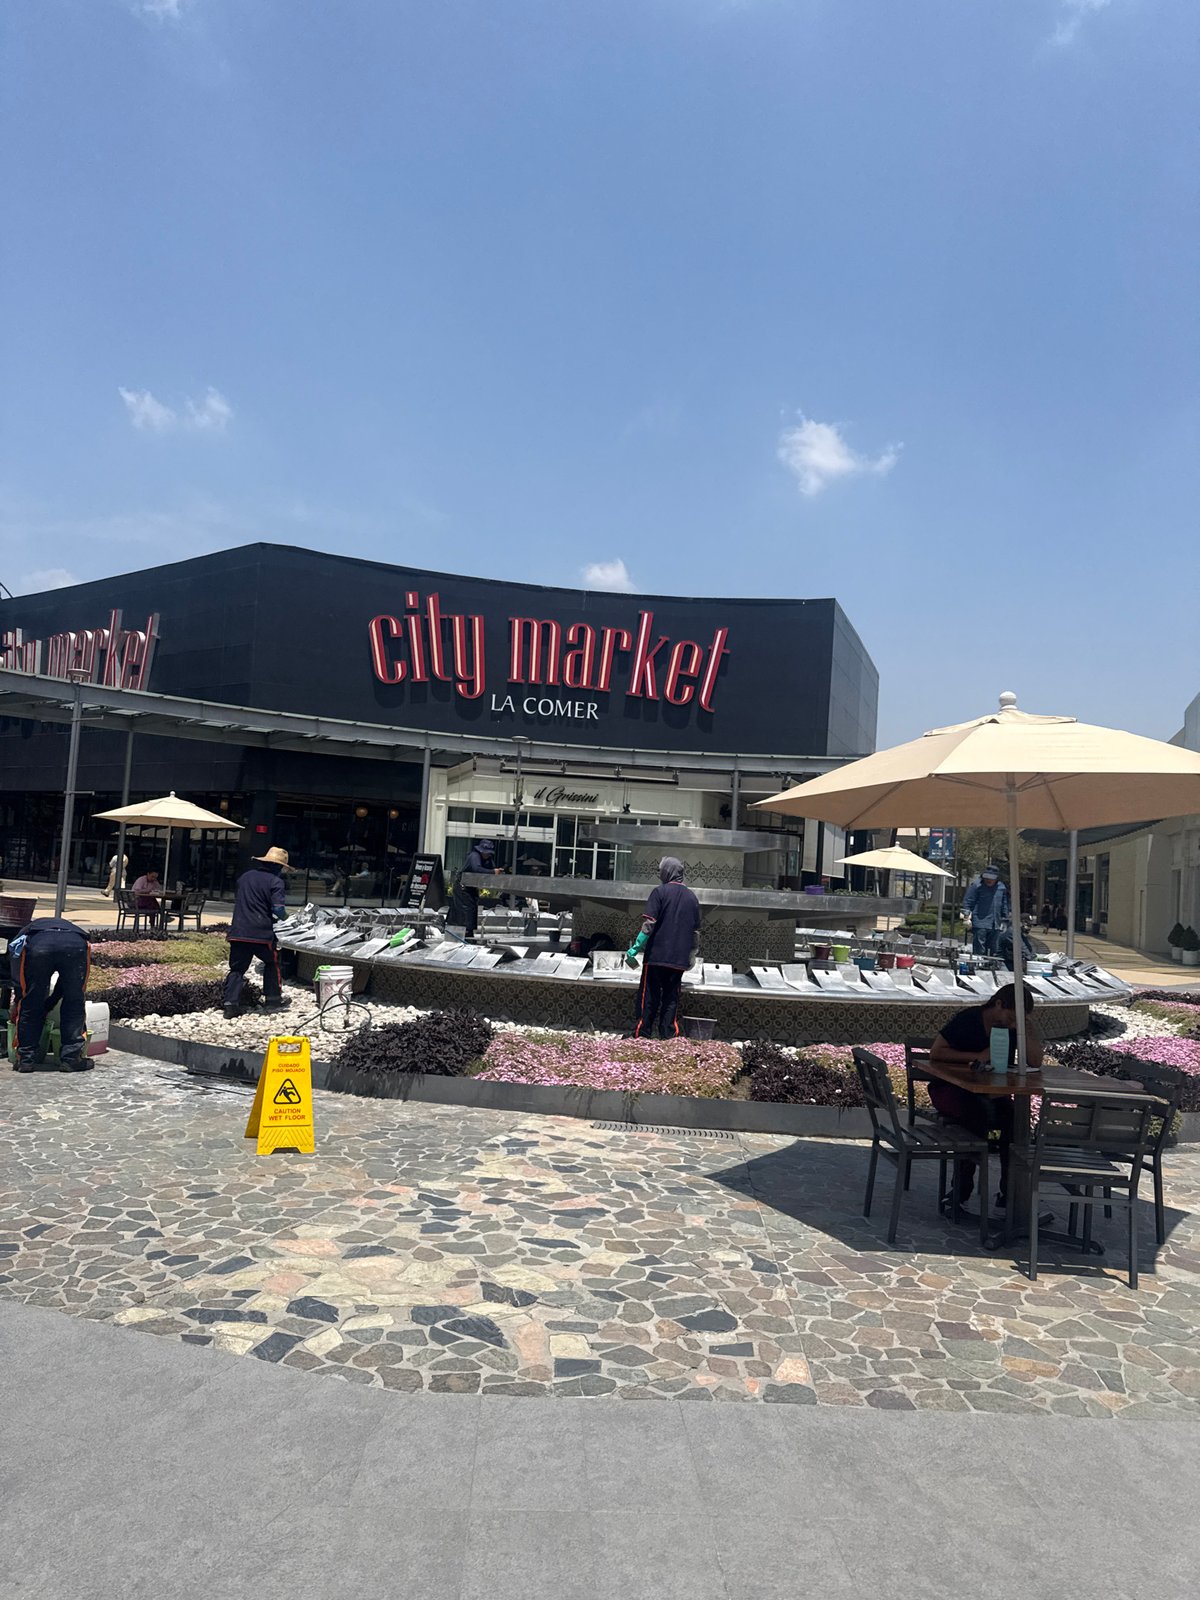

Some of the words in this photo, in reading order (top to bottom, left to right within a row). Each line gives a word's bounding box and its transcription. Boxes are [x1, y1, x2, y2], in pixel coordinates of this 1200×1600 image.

[47, 608, 161, 691] market
[369, 591, 485, 698] city
[508, 610, 731, 712] market
[491, 694, 515, 712] LA
[523, 697, 599, 719] COMER
[546, 785, 599, 805] Grissini
